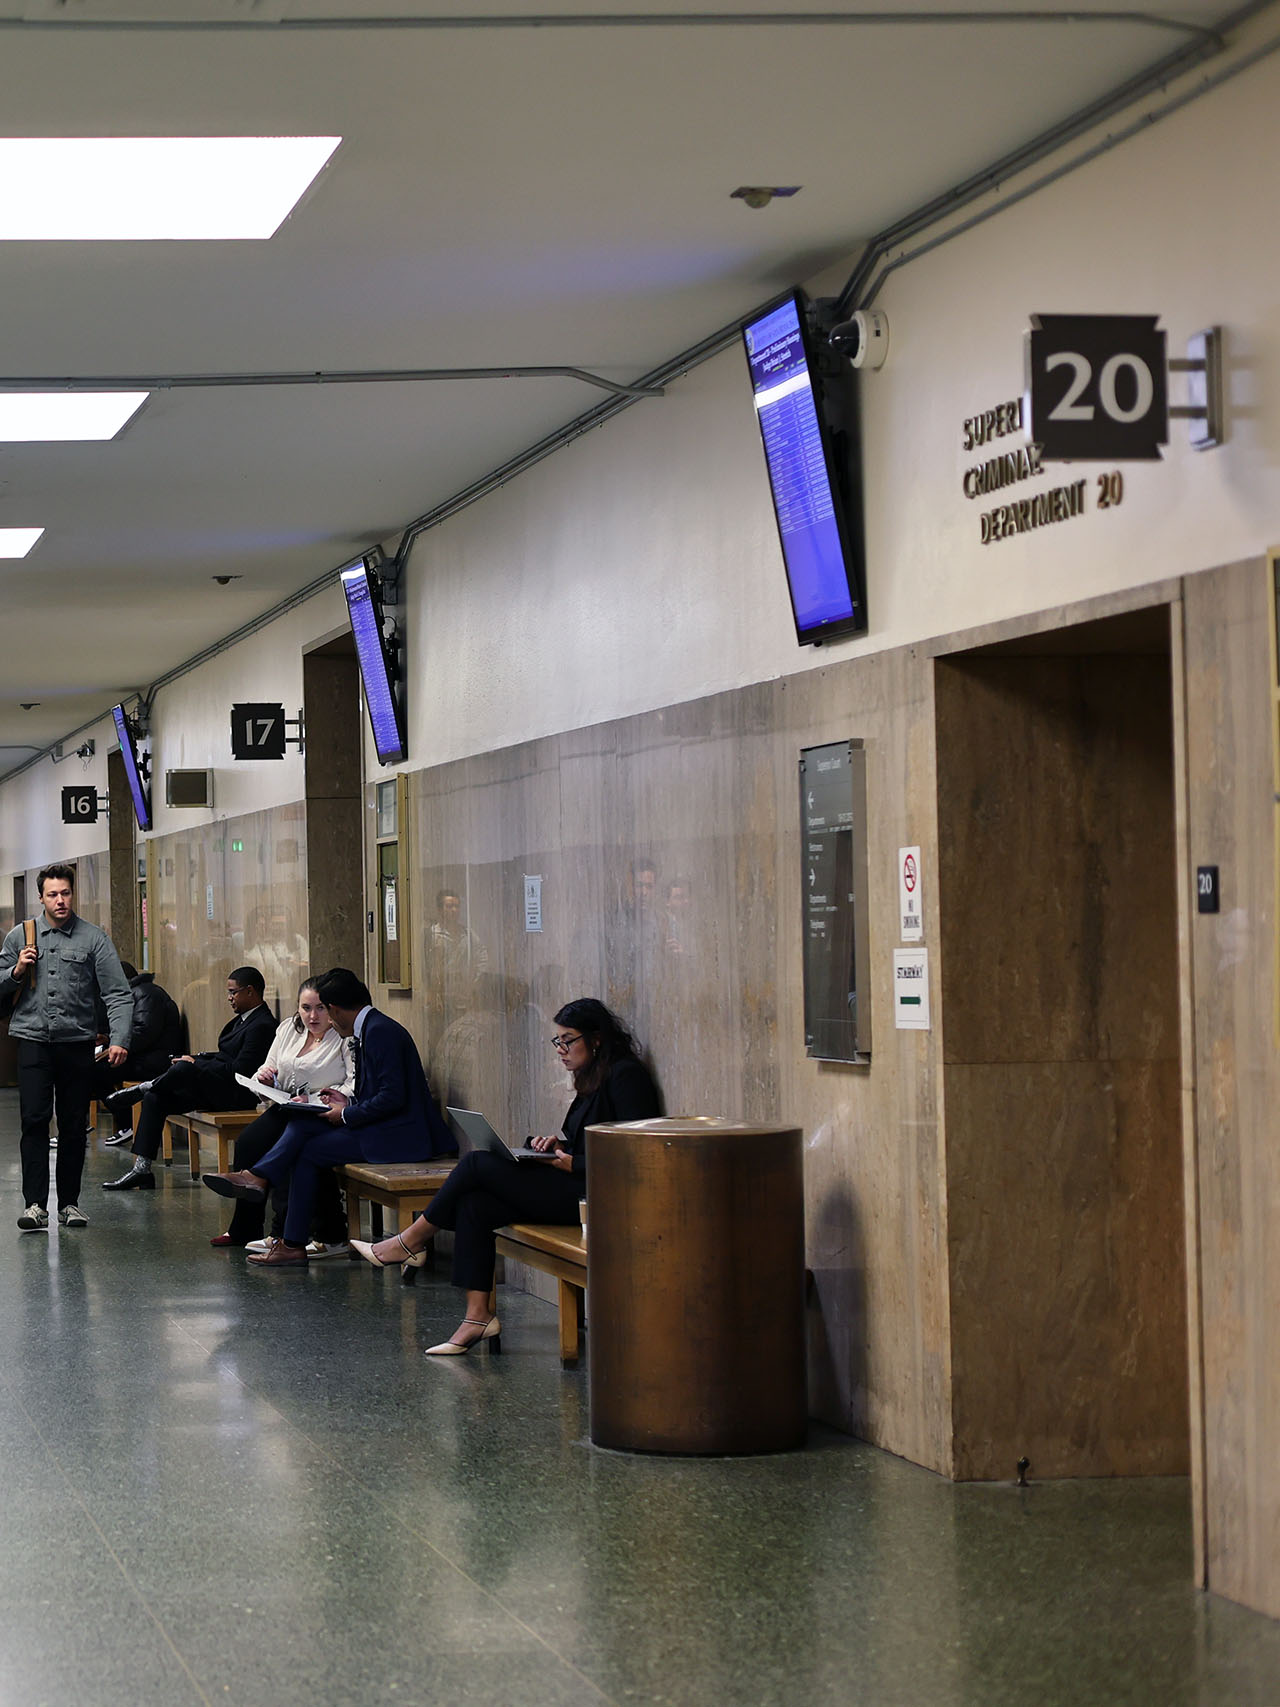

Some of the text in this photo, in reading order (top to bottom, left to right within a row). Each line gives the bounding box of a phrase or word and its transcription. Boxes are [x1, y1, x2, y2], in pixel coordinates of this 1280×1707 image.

[1046, 352, 1154, 423] 20
[963, 397, 1024, 451] SUPERI
[980, 470, 1124, 545] DEPARTMENT 20
[245, 718, 276, 746] 17
[70, 796, 90, 814] 16
[1199, 873, 1212, 894] 20
